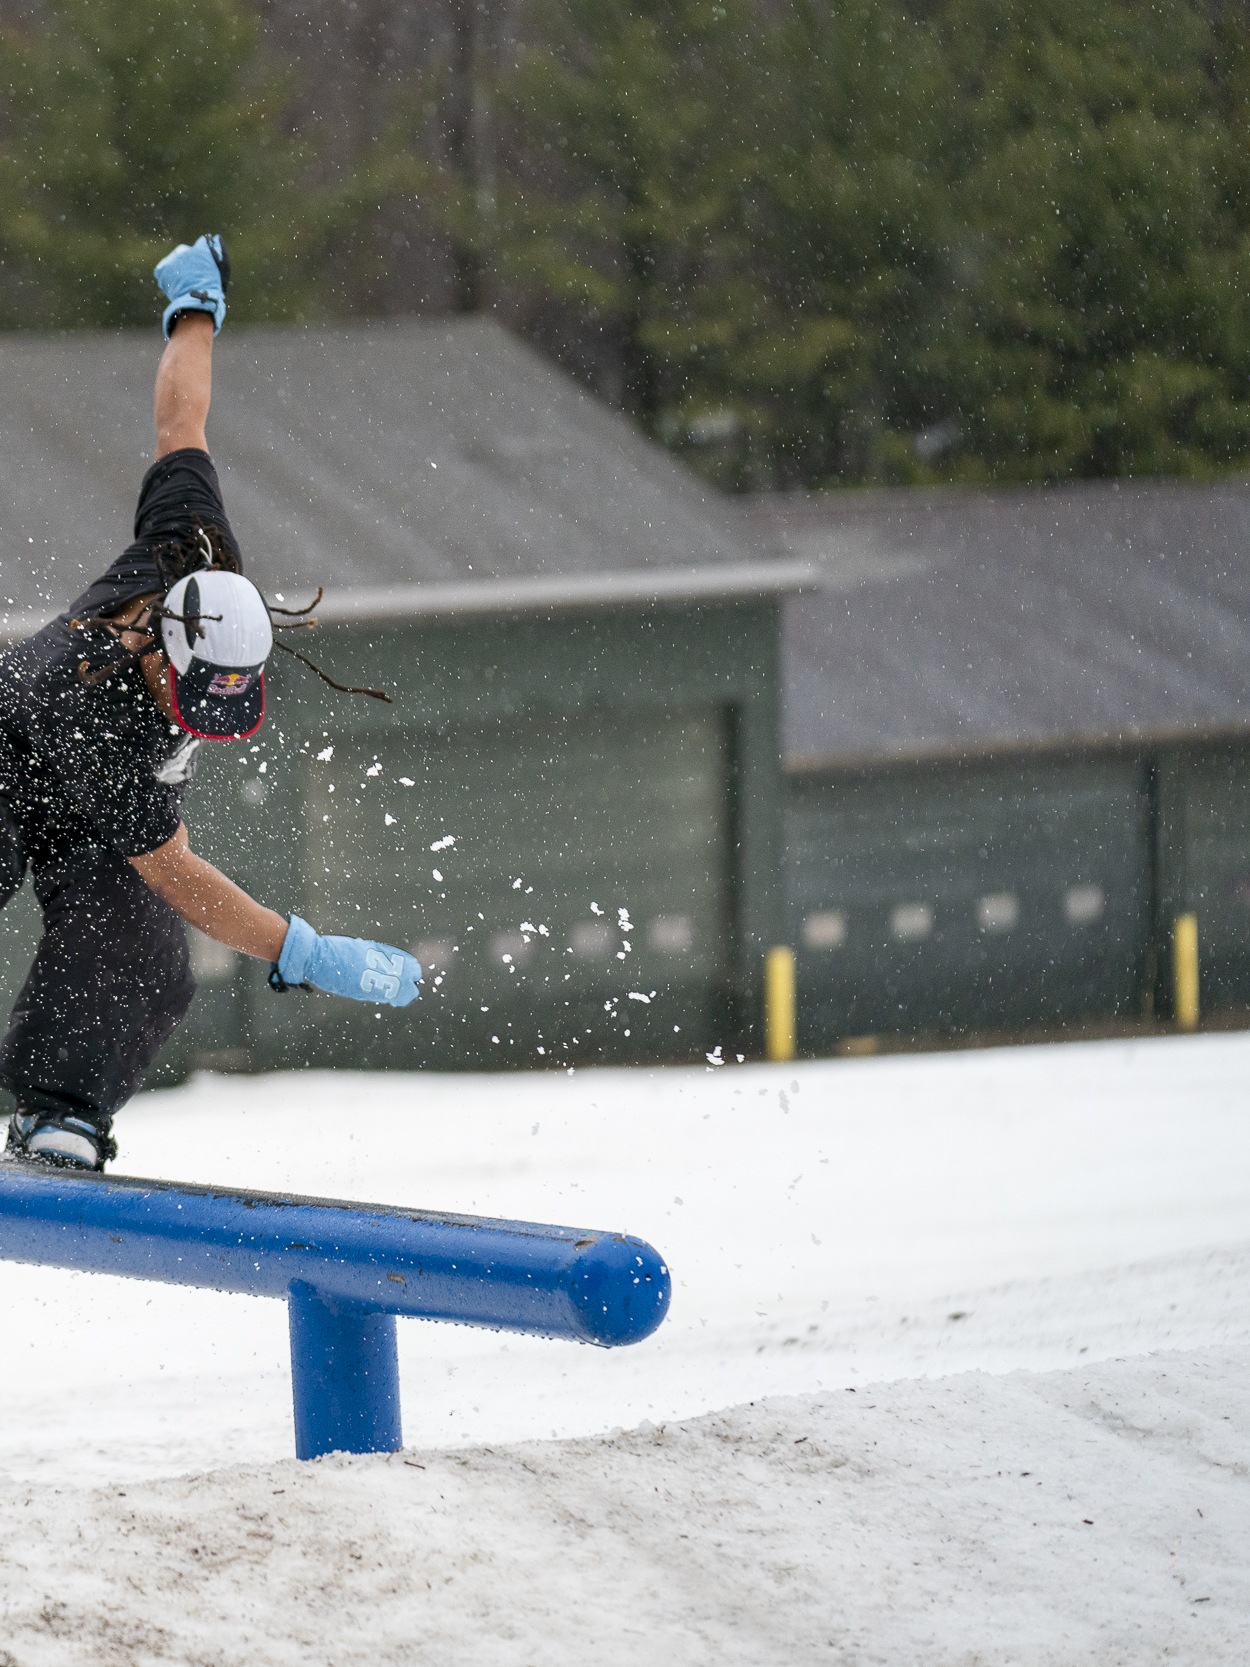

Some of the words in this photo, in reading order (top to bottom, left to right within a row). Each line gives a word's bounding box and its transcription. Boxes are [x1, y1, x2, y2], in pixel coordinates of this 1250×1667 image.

[207, 684, 229, 694] Red
[228, 683, 247, 695] Bull
[360, 948, 405, 999] 32
